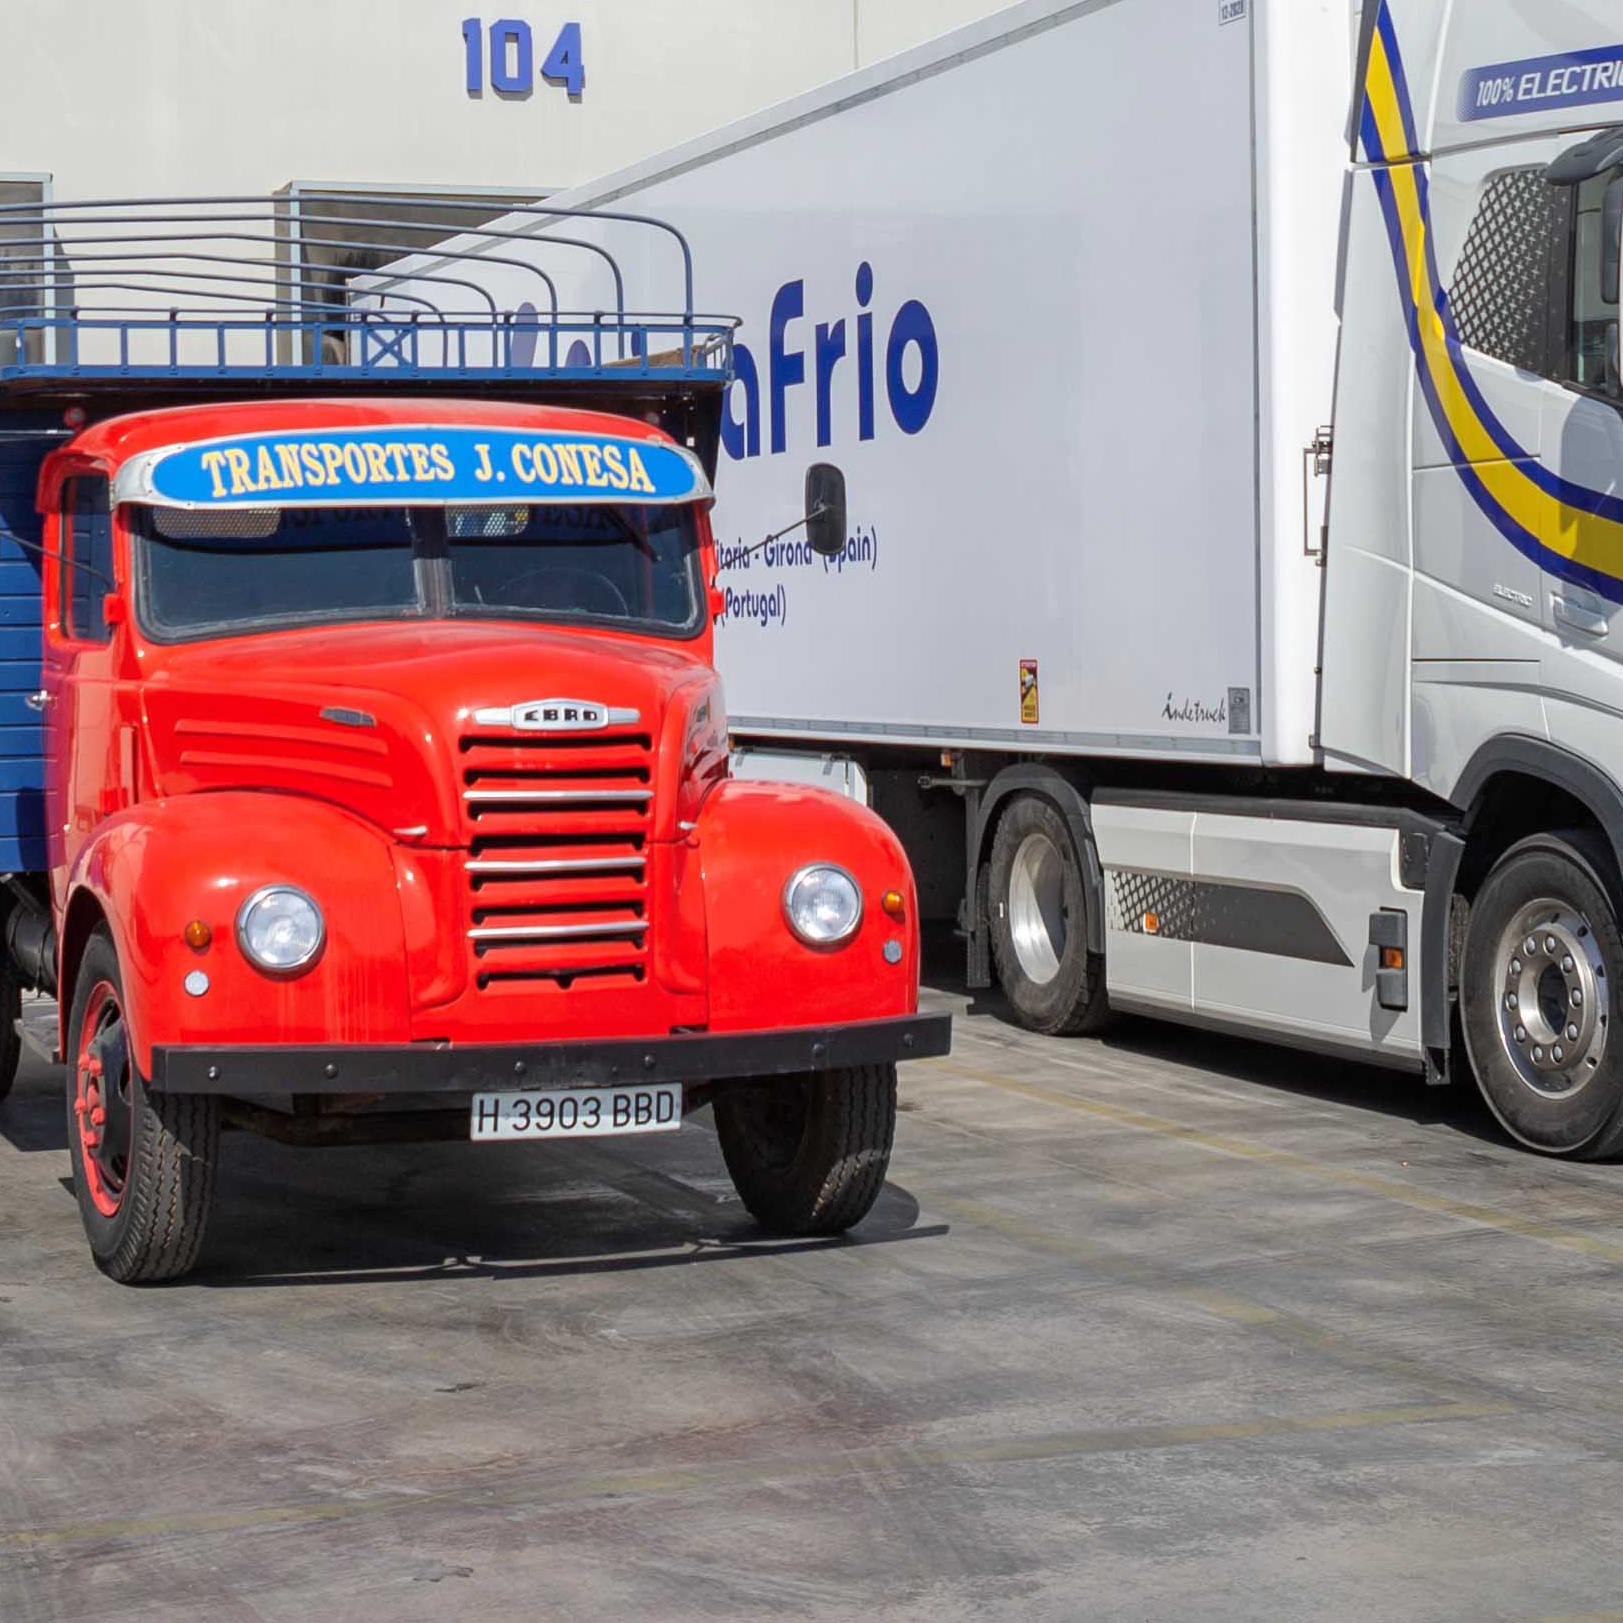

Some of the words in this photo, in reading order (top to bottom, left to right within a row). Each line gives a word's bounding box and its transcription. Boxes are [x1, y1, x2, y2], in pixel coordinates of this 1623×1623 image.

[462, 18, 585, 97] 104
[1477, 76, 1515, 107] 100%
[201, 442, 455, 498] TRANSPORTES
[475, 443, 505, 482] J.
[511, 442, 656, 493] CONESA
[478, 1098, 500, 1133] H
[511, 1096, 602, 1132] 3903
[612, 1091, 674, 1128] BBD
